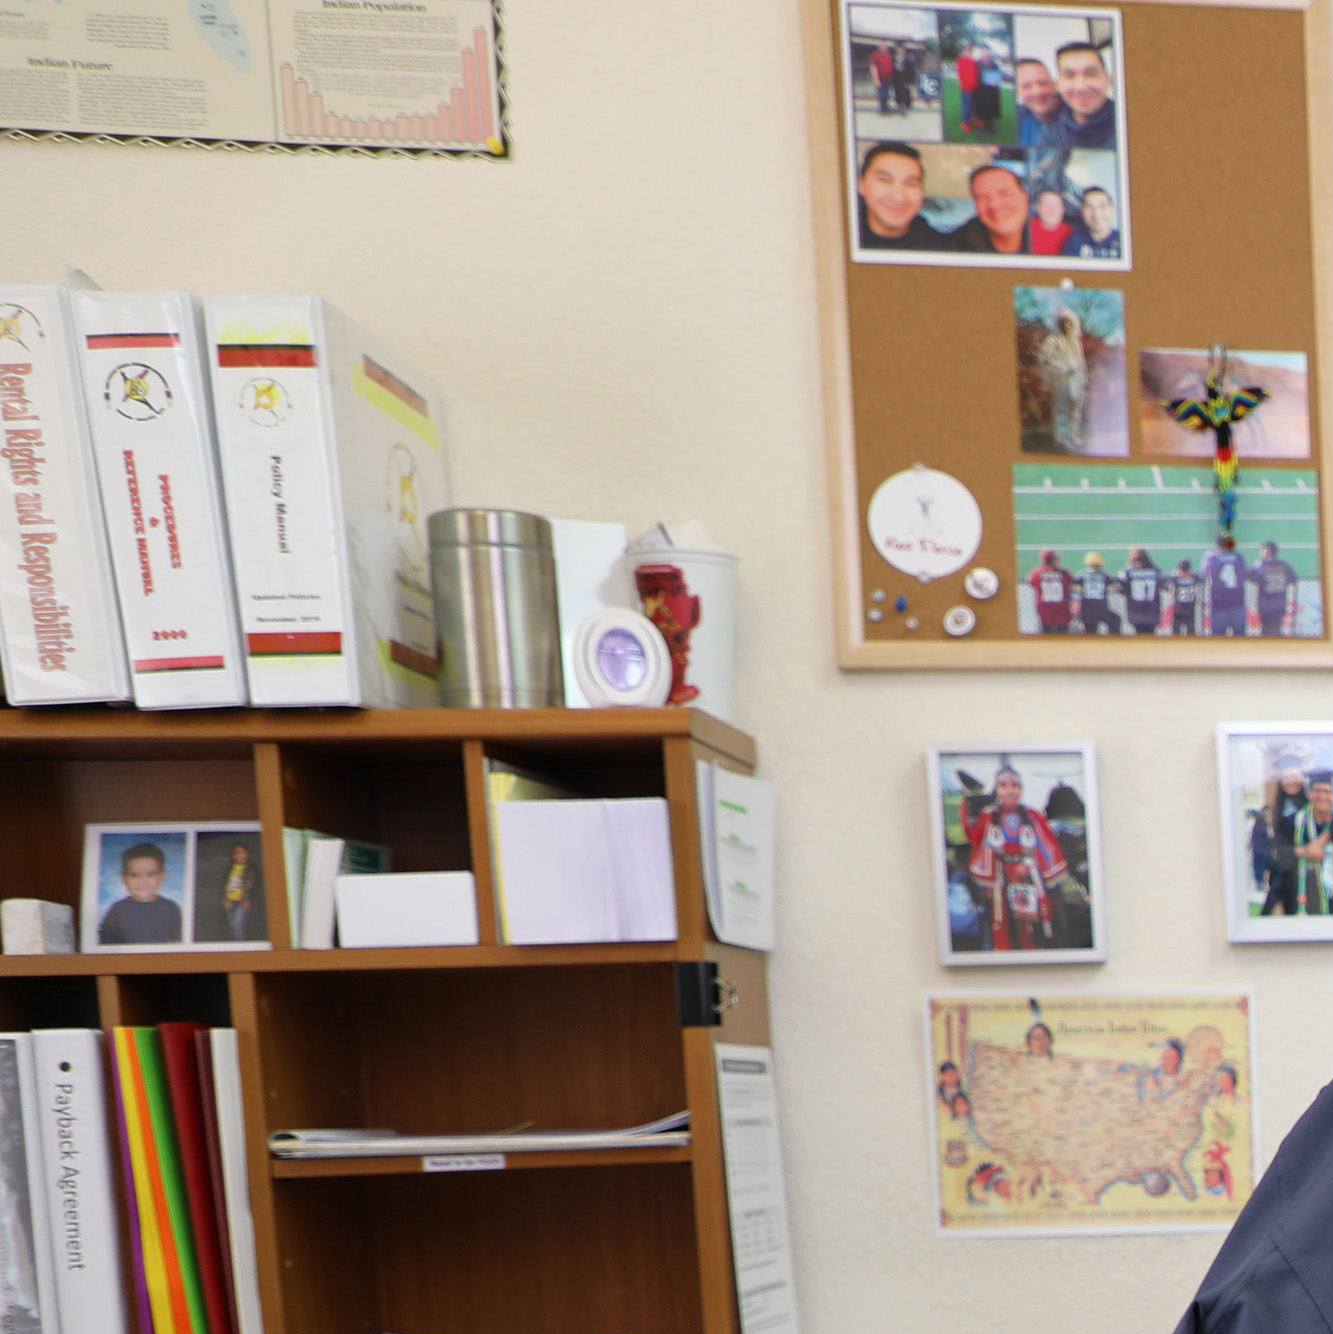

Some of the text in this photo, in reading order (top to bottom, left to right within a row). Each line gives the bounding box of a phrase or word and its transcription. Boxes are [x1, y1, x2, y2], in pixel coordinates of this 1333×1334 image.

[0, 363, 76, 673] Rental Rights and Responsibilities
[122, 449, 146, 538] REFERENCE
[158, 473, 182, 569] PROCEDURES
[270, 455, 291, 554] Policy Manual
[53, 1083, 85, 1271] Payback Agreement
